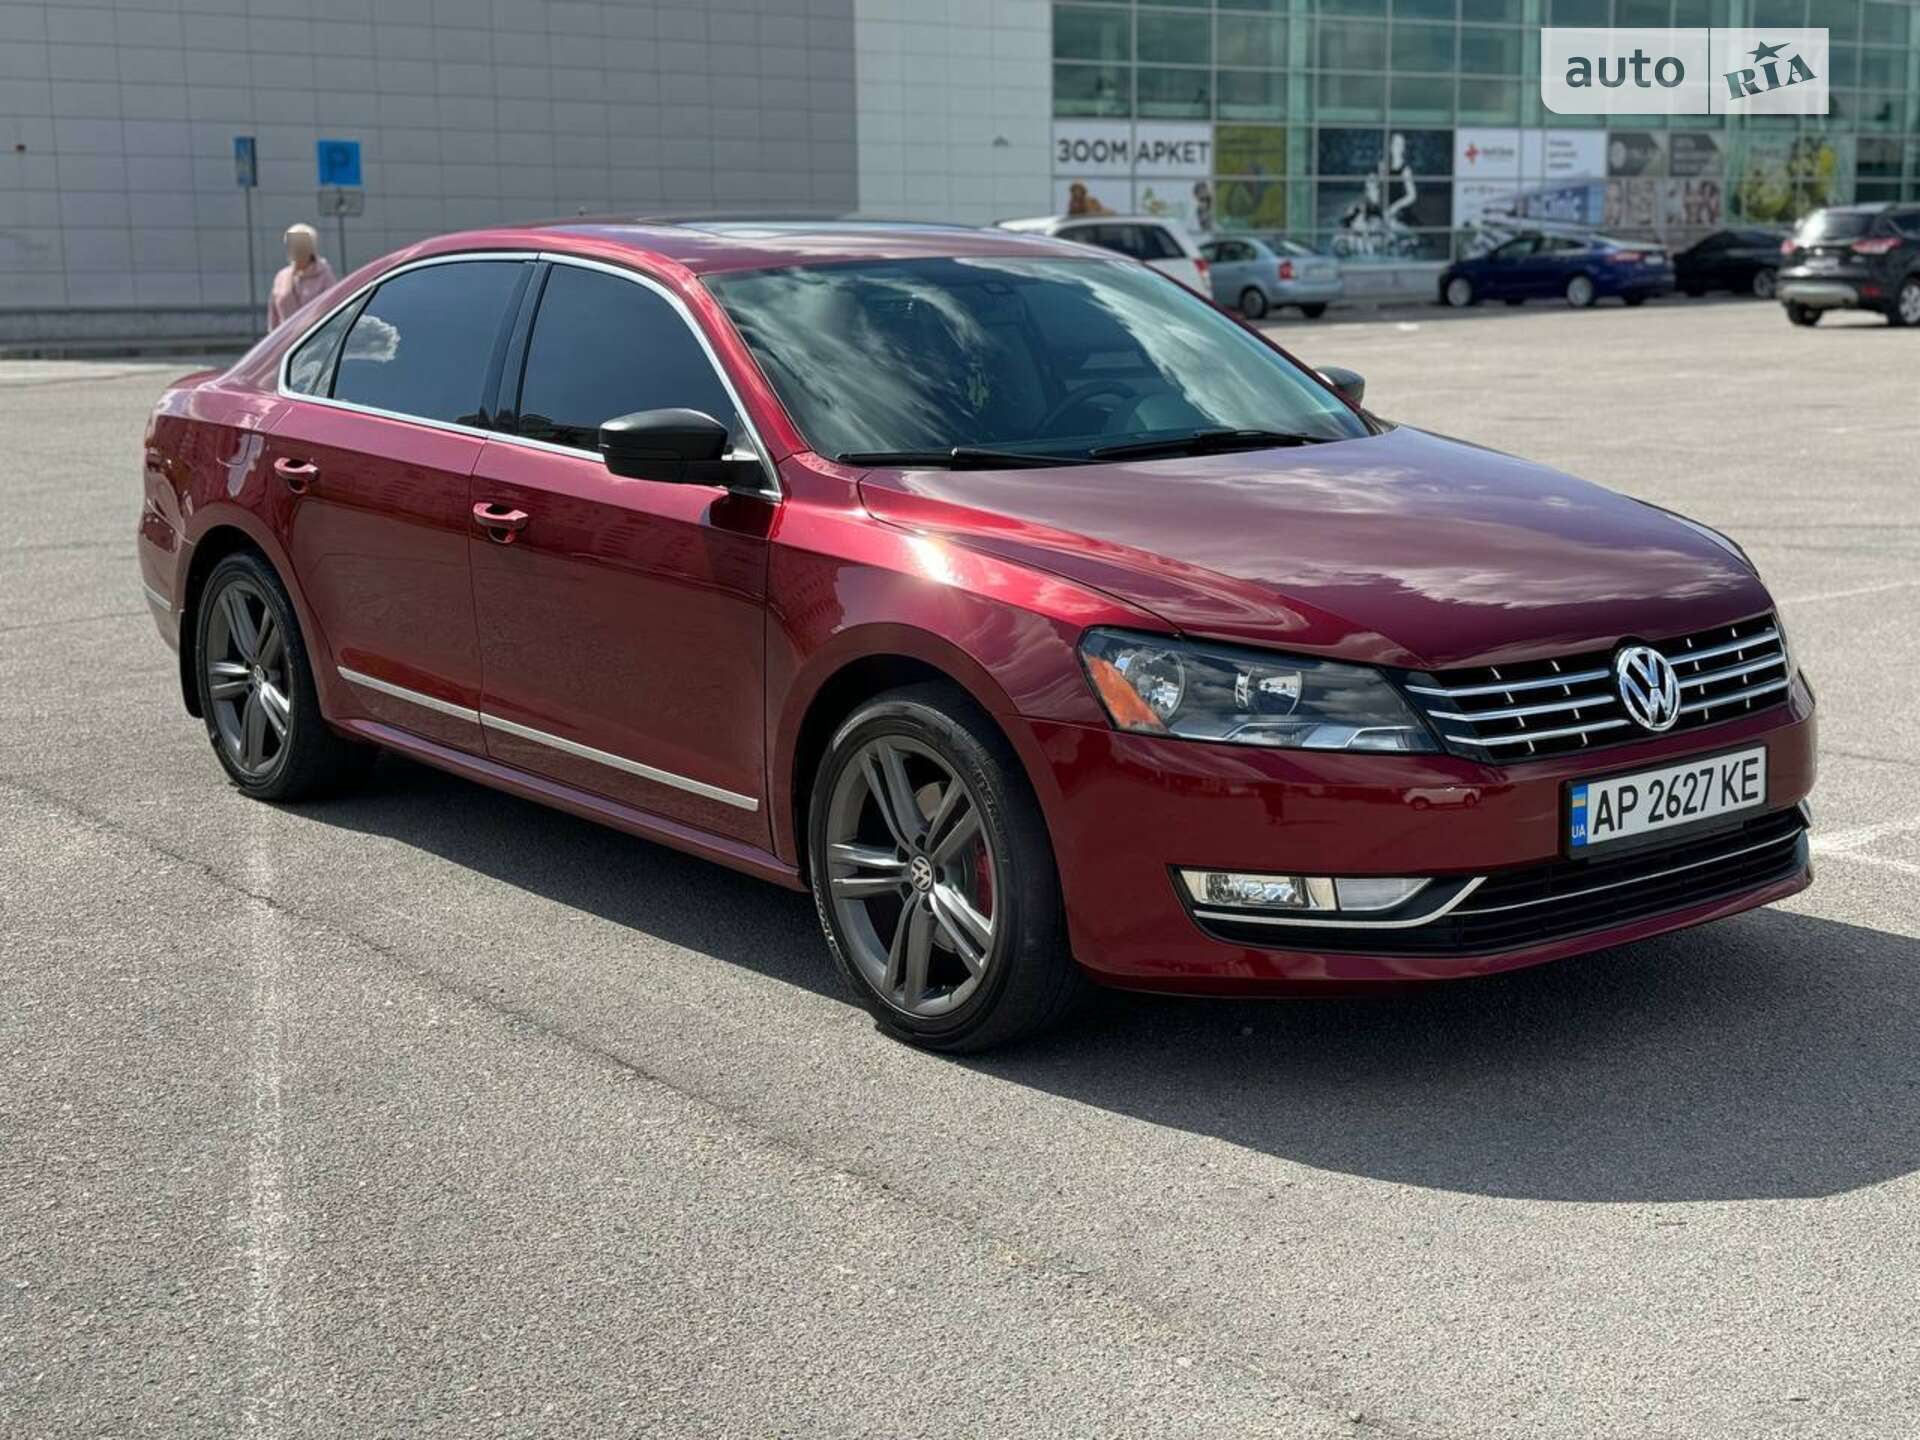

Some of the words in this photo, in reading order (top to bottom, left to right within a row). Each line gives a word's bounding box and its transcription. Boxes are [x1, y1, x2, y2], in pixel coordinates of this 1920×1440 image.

[1593, 784, 1639, 835] AP
[1647, 767, 1715, 824] 2627
[1721, 757, 1760, 807] KE
[1571, 823, 1587, 839] UA
